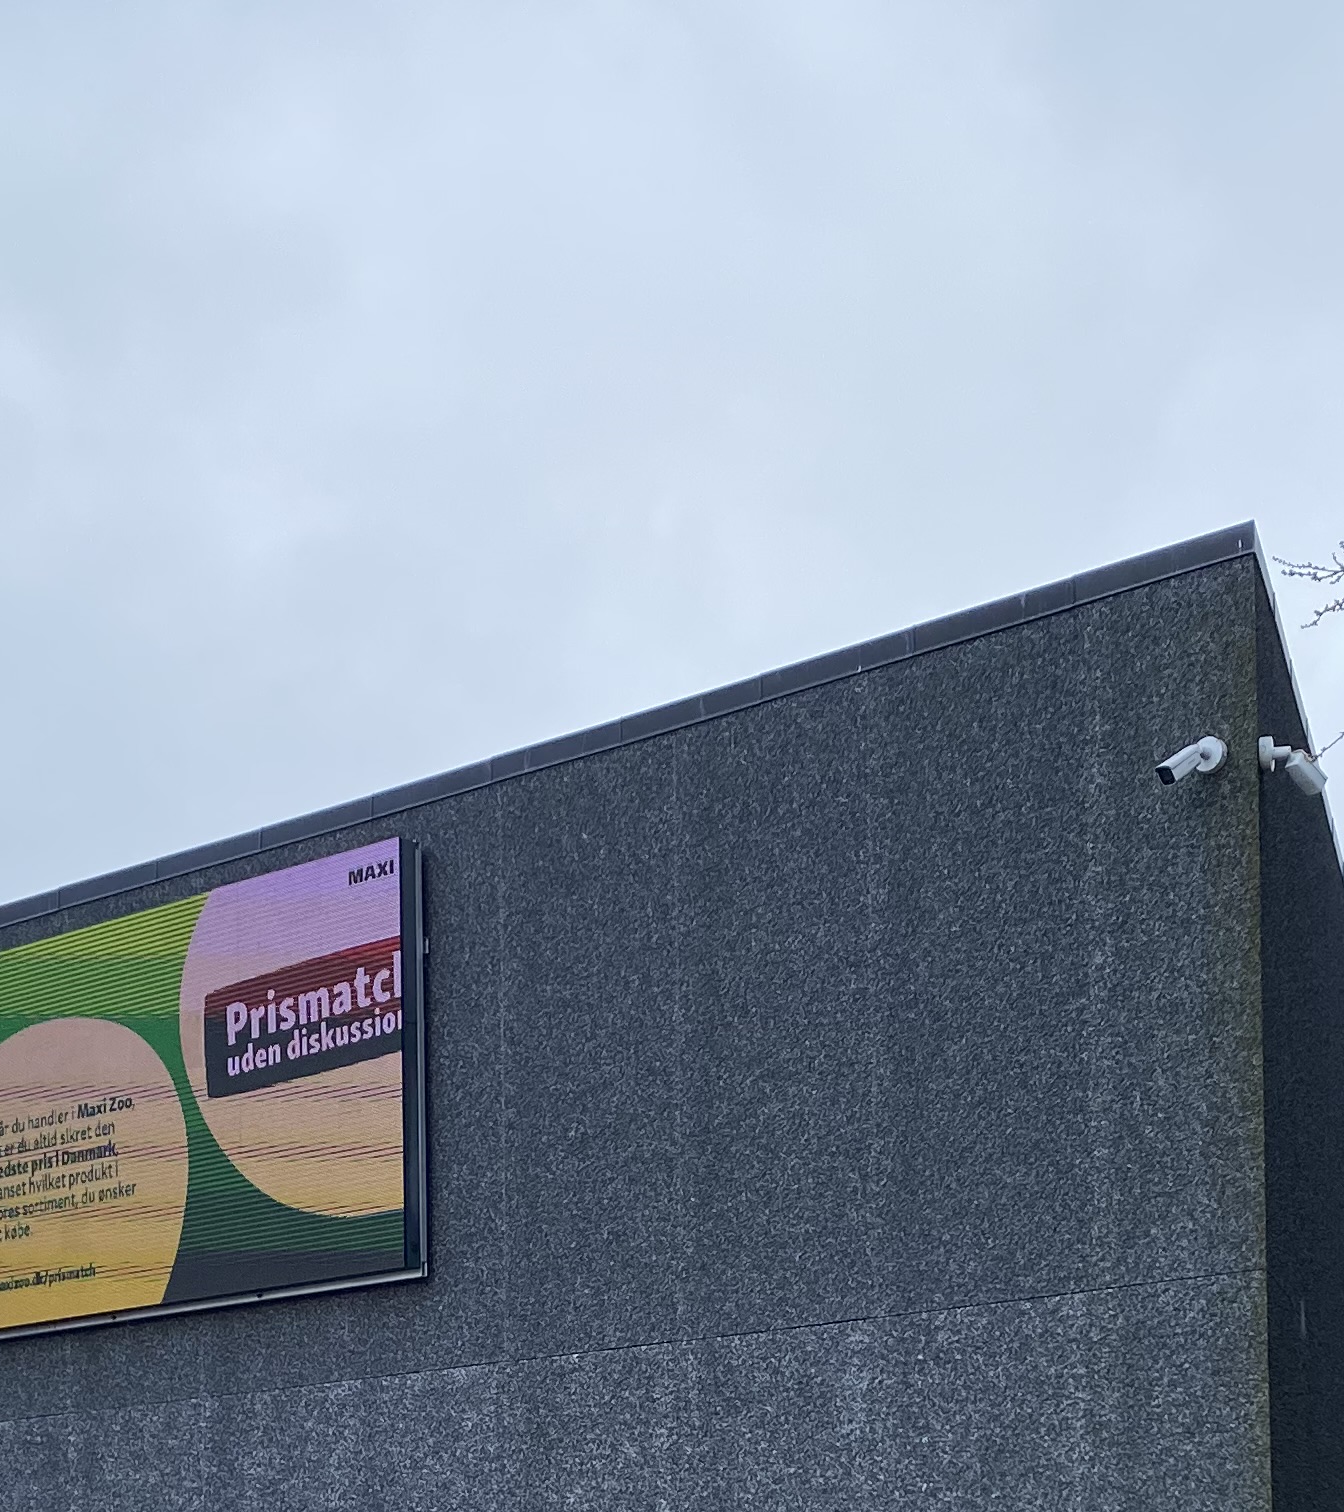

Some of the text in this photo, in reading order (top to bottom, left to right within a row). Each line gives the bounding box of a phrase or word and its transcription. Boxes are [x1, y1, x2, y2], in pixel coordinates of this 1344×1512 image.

[348, 859, 395, 886] MAXI
[227, 1042, 282, 1077] uden
[11, 1117, 25, 1134] du
[77, 1098, 107, 1119] Maxi
[17, 1137, 31, 1152] du
[34, 1131, 58, 1150] altid
[60, 1126, 93, 1146] sikret
[95, 1120, 116, 1138] den
[28, 1172, 66, 1194] hvilket
[69, 1162, 114, 1190] produkt
[31, 1152, 53, 1177] pris
[81, 1187, 95, 1204] du
[98, 1181, 137, 1202] ønsker
